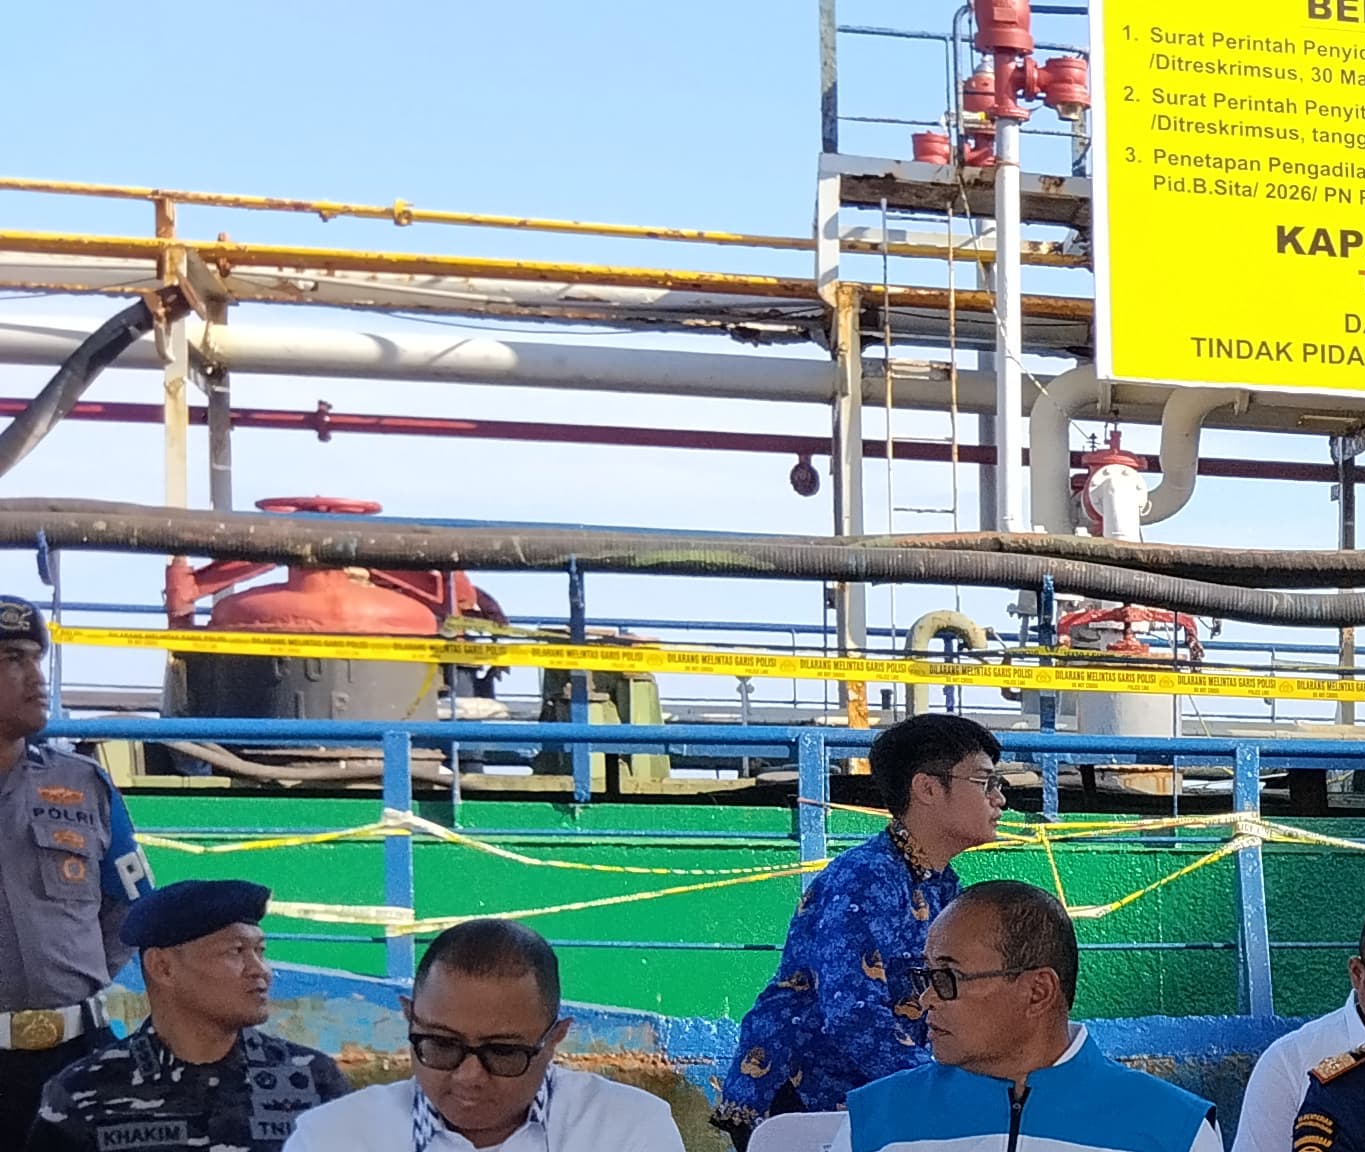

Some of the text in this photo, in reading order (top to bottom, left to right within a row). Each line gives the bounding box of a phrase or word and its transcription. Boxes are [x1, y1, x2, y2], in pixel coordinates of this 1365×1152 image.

[1124, 26, 1138, 41] 1.
[1151, 27, 1204, 46] Surat
[1213, 32, 1295, 53] Perintah
[1150, 54, 1302, 80] /Ditreskrimsus,
[1312, 67, 1332, 83] 30
[1124, 86, 1139, 101] 2.
[1152, 88, 1206, 107] Surat
[1214, 93, 1296, 114] Perintah
[1152, 115, 1304, 142] /Ditreskrimsus,
[1126, 147, 1140, 162] 3.
[1154, 149, 1260, 173] Penetapan
[1154, 175, 1258, 197] Pid.B.Sita/
[1266, 183, 1317, 201] 2026/
[1325, 187, 1351, 203] PN
[1191, 337, 1292, 362] TINDAK
[668, 653, 776, 667] DILARANG MELINTAS GARIS POLISI
[800, 659, 906, 673] DILARANG MELINTAS GARIS POLISI
[1055, 670, 1156, 684] DILARANG MELINTAS GARIS POLISI
[1178, 676, 1275, 689] DILARANG MELINTAS GARIS POLISI
[1297, 681, 1324, 691] DILARANG
[1327, 682, 1353, 692] MELINTAS
[33, 807, 94, 825] POLRI
[103, 1125, 181, 1146] KHAKIM
[257, 1122, 292, 1137] TNI
